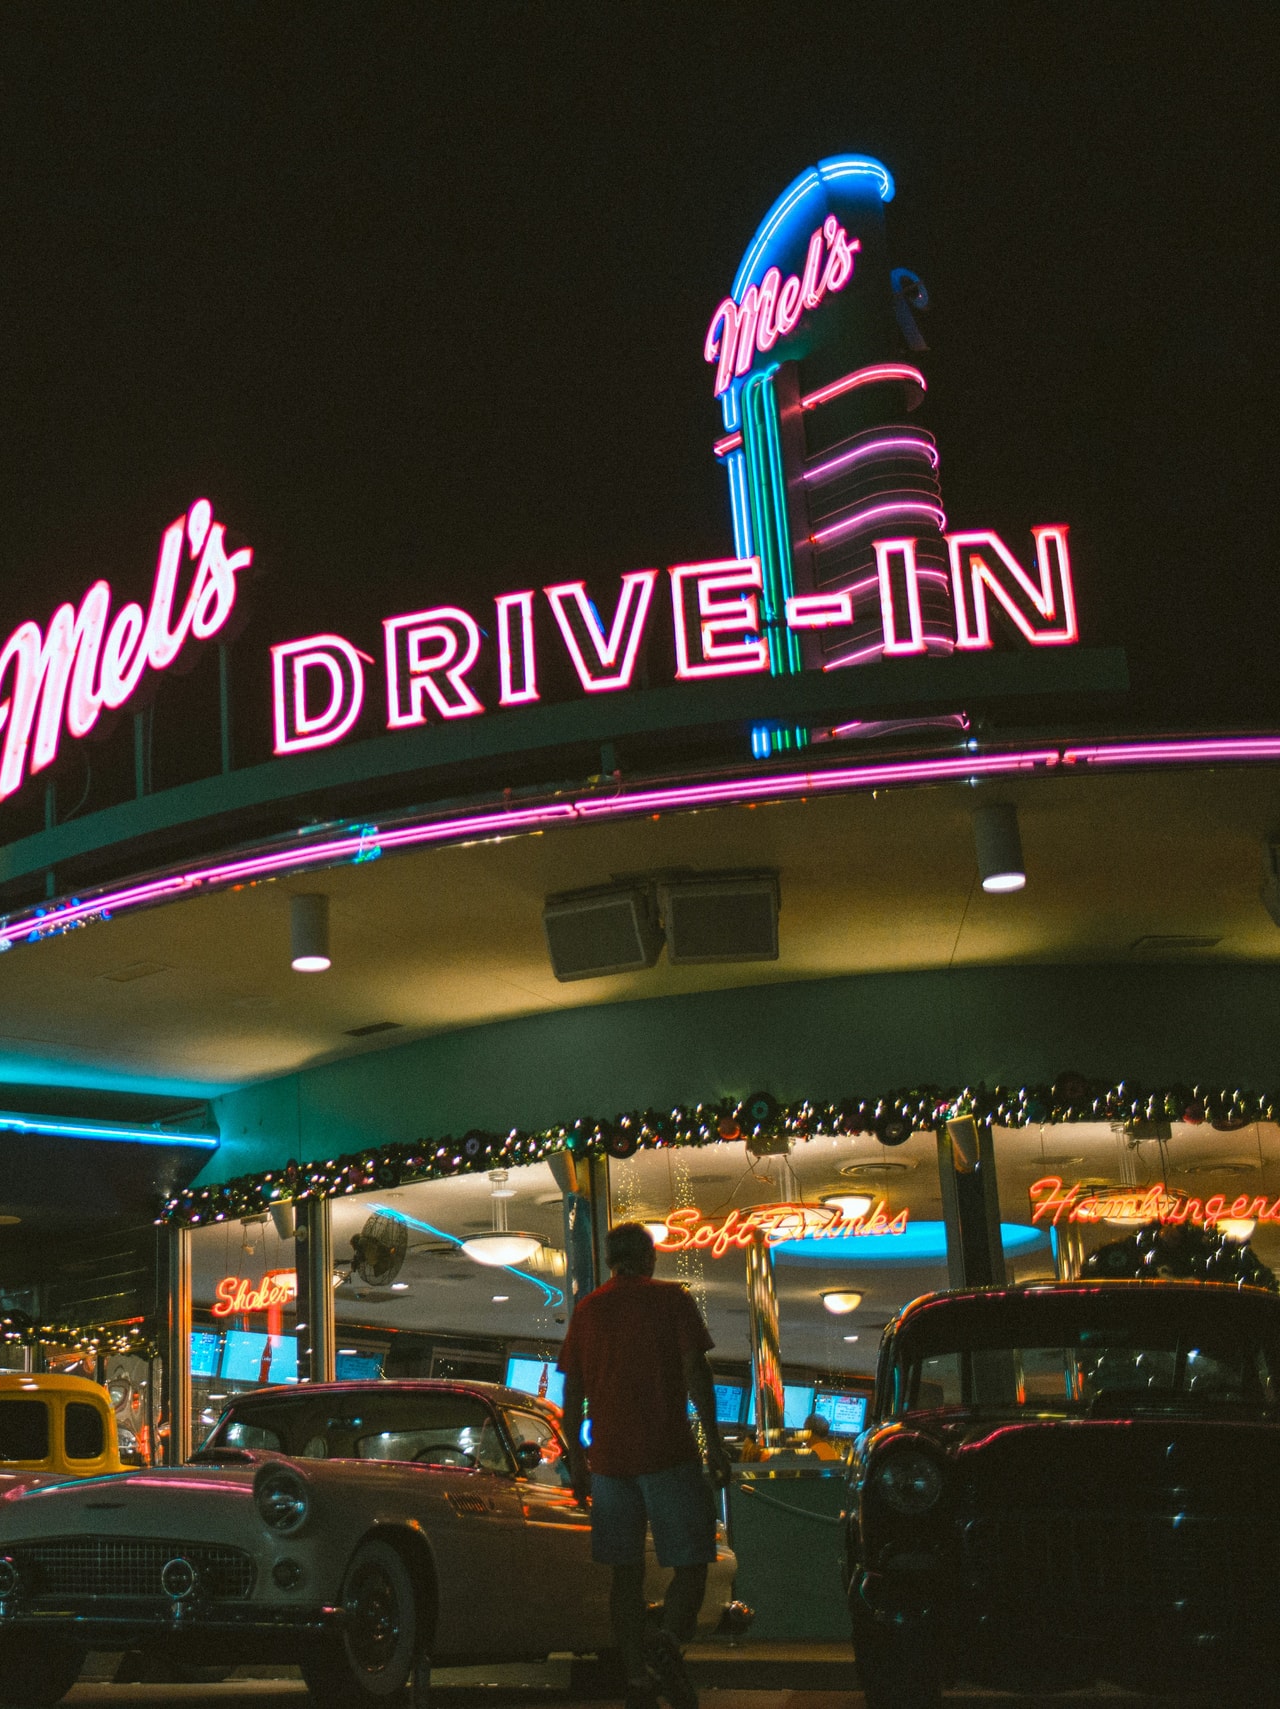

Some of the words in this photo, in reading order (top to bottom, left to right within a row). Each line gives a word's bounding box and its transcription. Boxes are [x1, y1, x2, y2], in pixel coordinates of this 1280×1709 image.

[704, 213, 861, 398] Mel's
[270, 524, 1080, 756] DRIVE-IN
[655, 1207, 759, 1259] Soft
[762, 1200, 909, 1248] Drinks
[213, 1276, 292, 1316] Shakes
